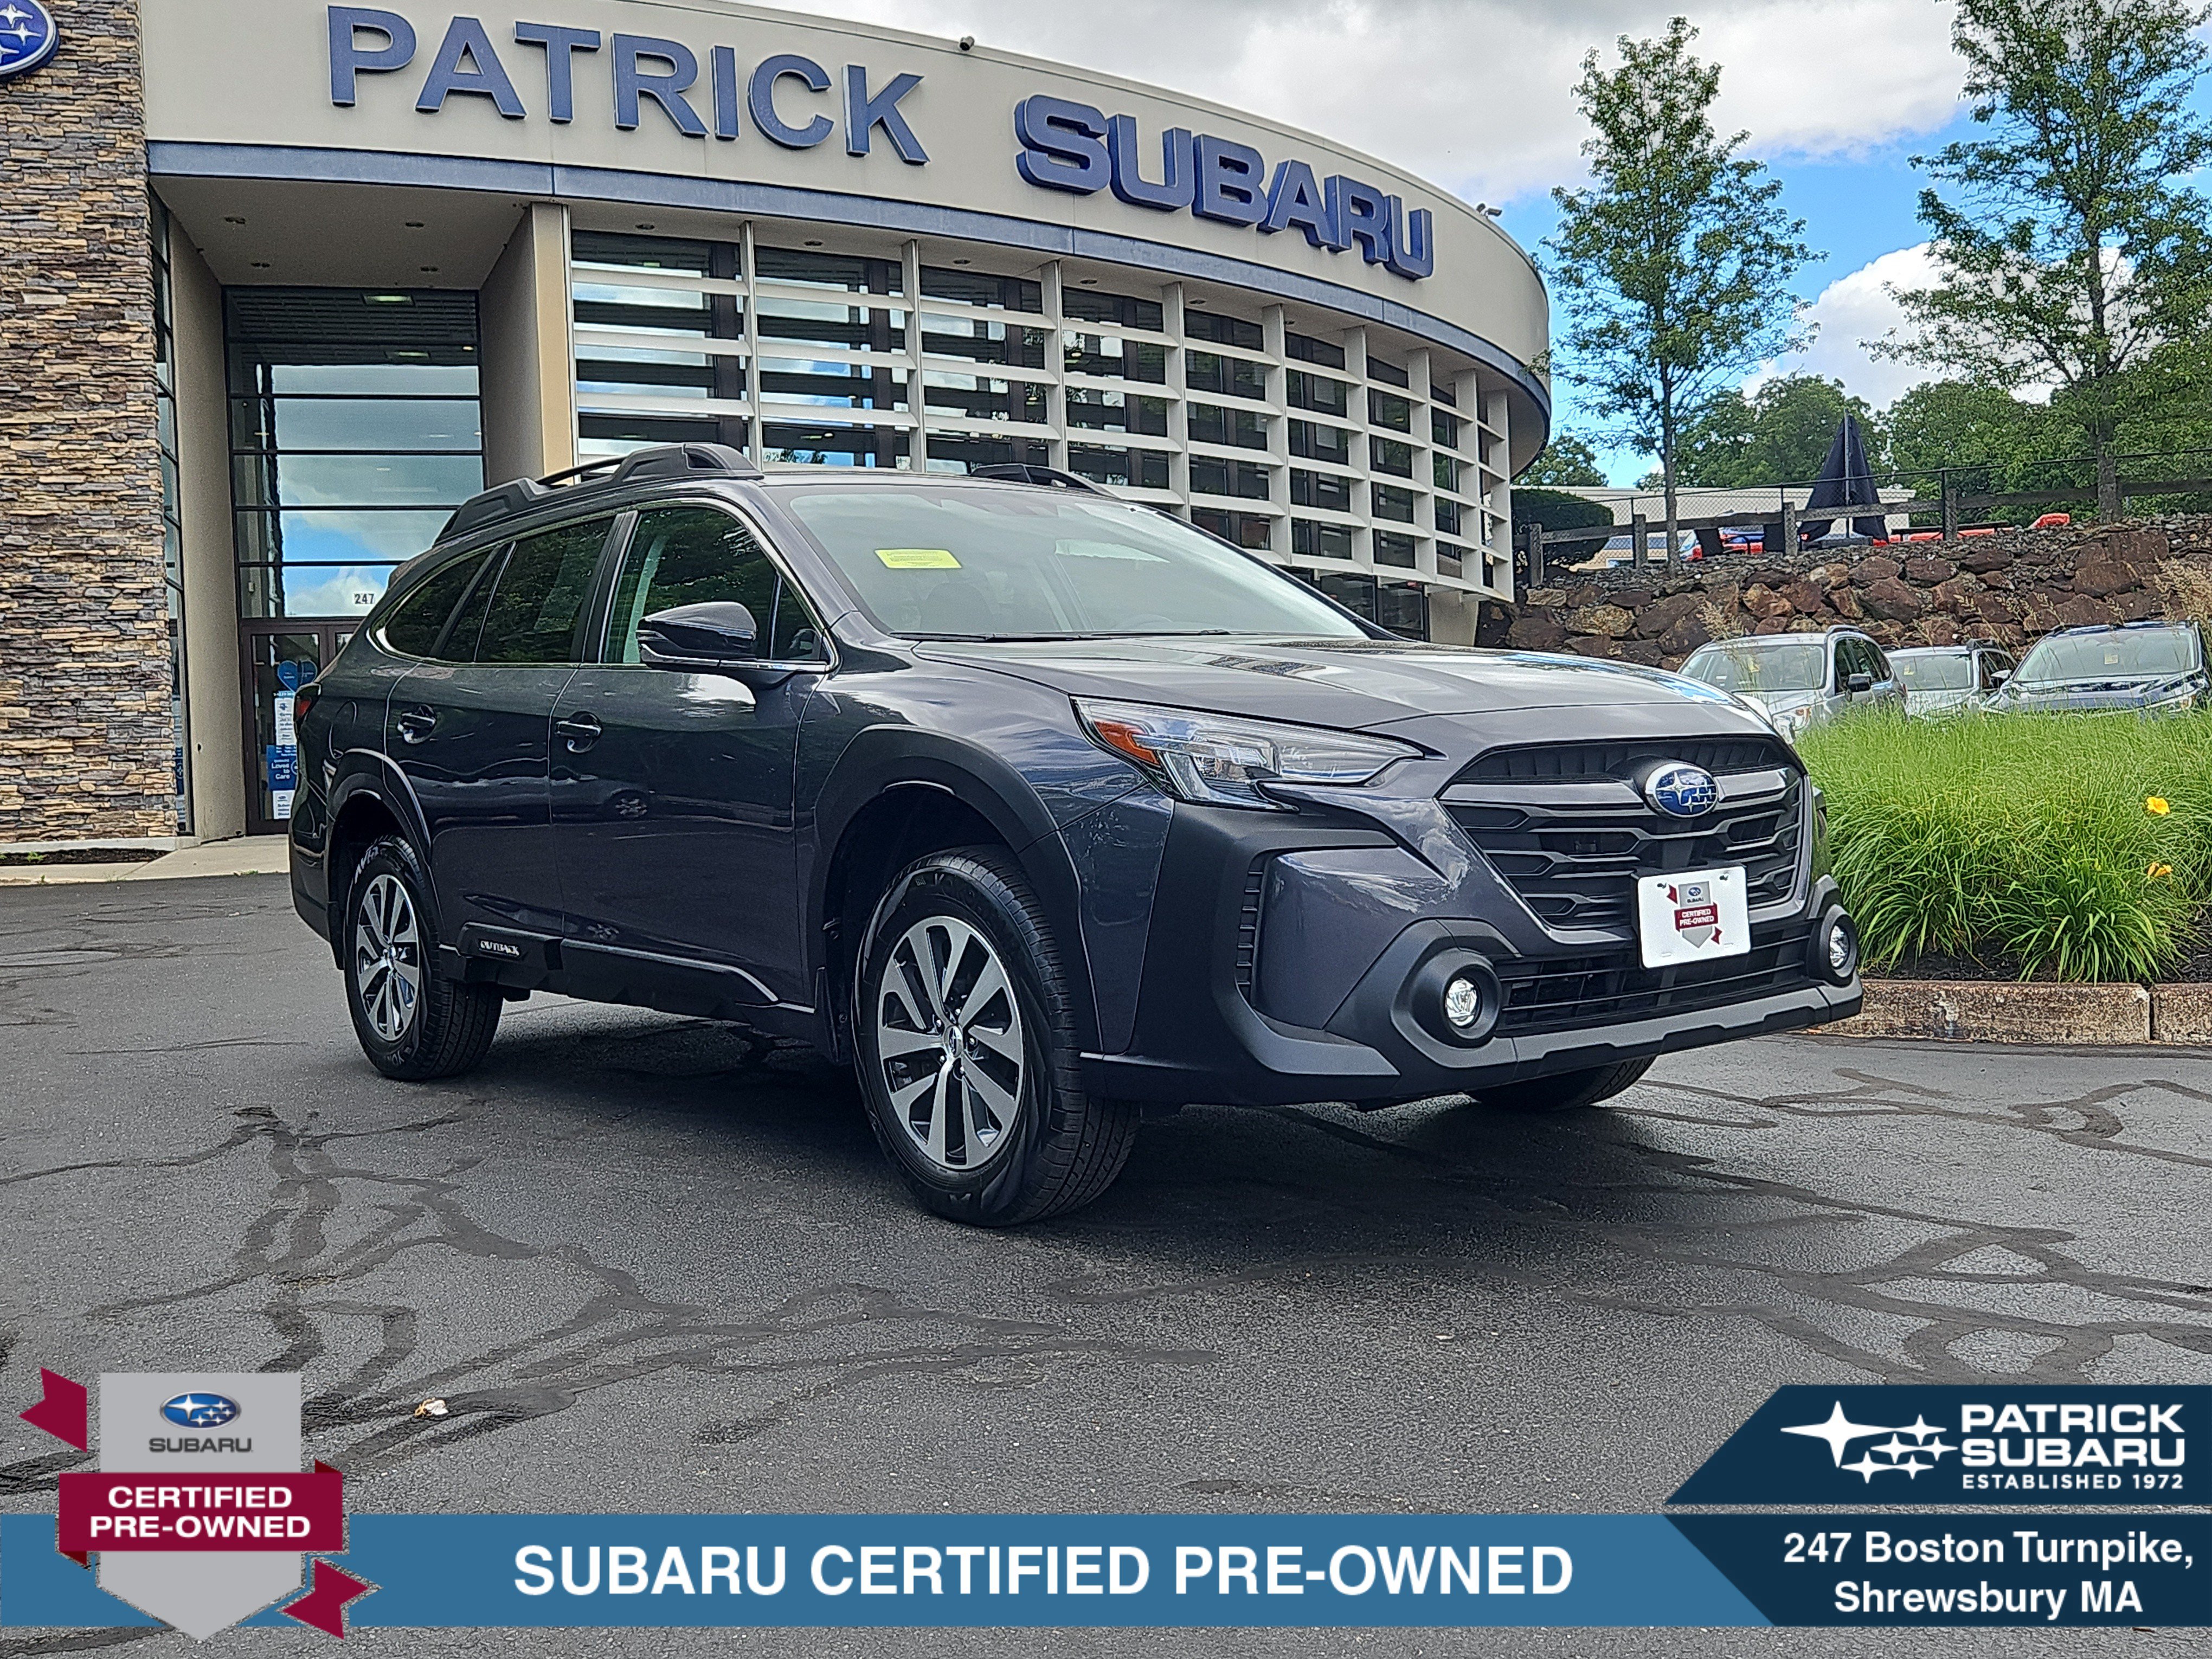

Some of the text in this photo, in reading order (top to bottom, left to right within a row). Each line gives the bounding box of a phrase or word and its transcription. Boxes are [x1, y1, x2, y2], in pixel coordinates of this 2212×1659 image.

[326, 5, 1433, 281] PATRICK SUBARU
[354, 593, 374, 605] 247
[1682, 909, 1711, 918] CERTIFIED
[1680, 916, 1714, 927] PRE-OWNED
[480, 940, 520, 956] OUTBACK
